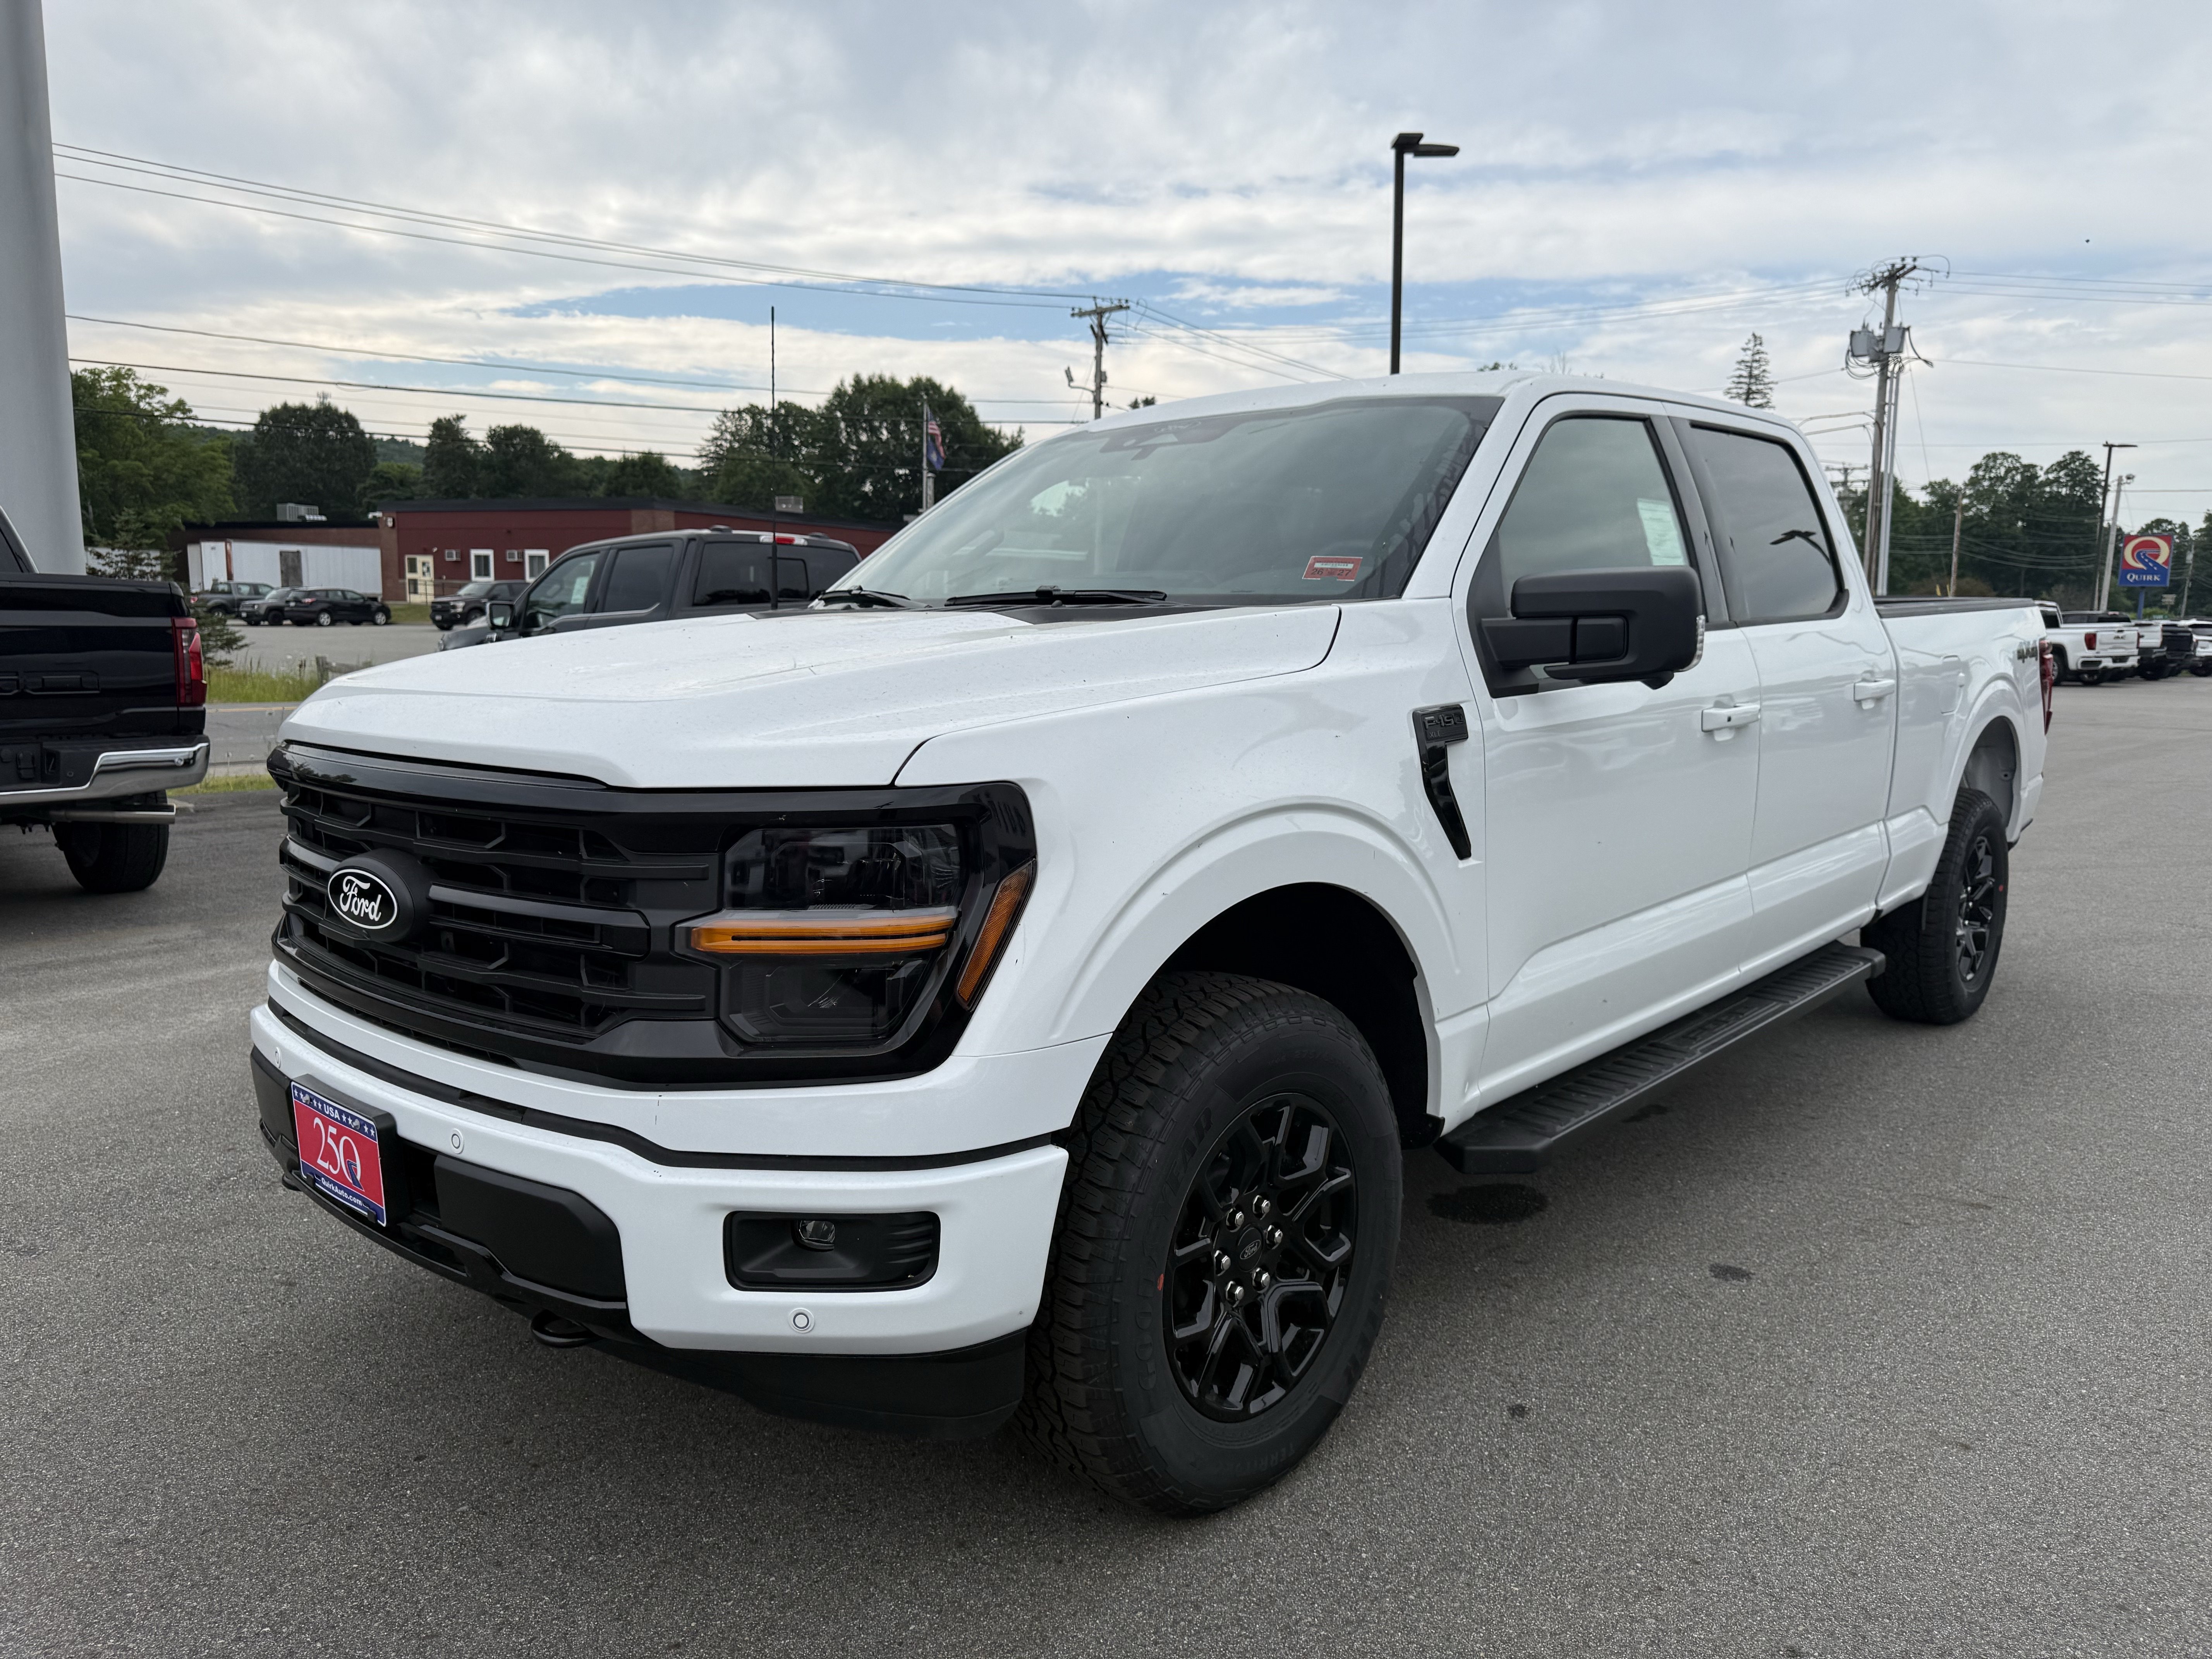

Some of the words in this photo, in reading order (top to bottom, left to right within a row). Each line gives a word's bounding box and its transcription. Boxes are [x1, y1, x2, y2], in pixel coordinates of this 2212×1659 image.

[2126, 572, 2160, 582] QUIRK
[1424, 714, 1464, 730] F-150
[340, 876, 382, 921] Ford
[323, 1103, 340, 1121] USA
[321, 1176, 363, 1207] QuirkAuto.com
[1244, 1242, 1258, 1258] Ford
